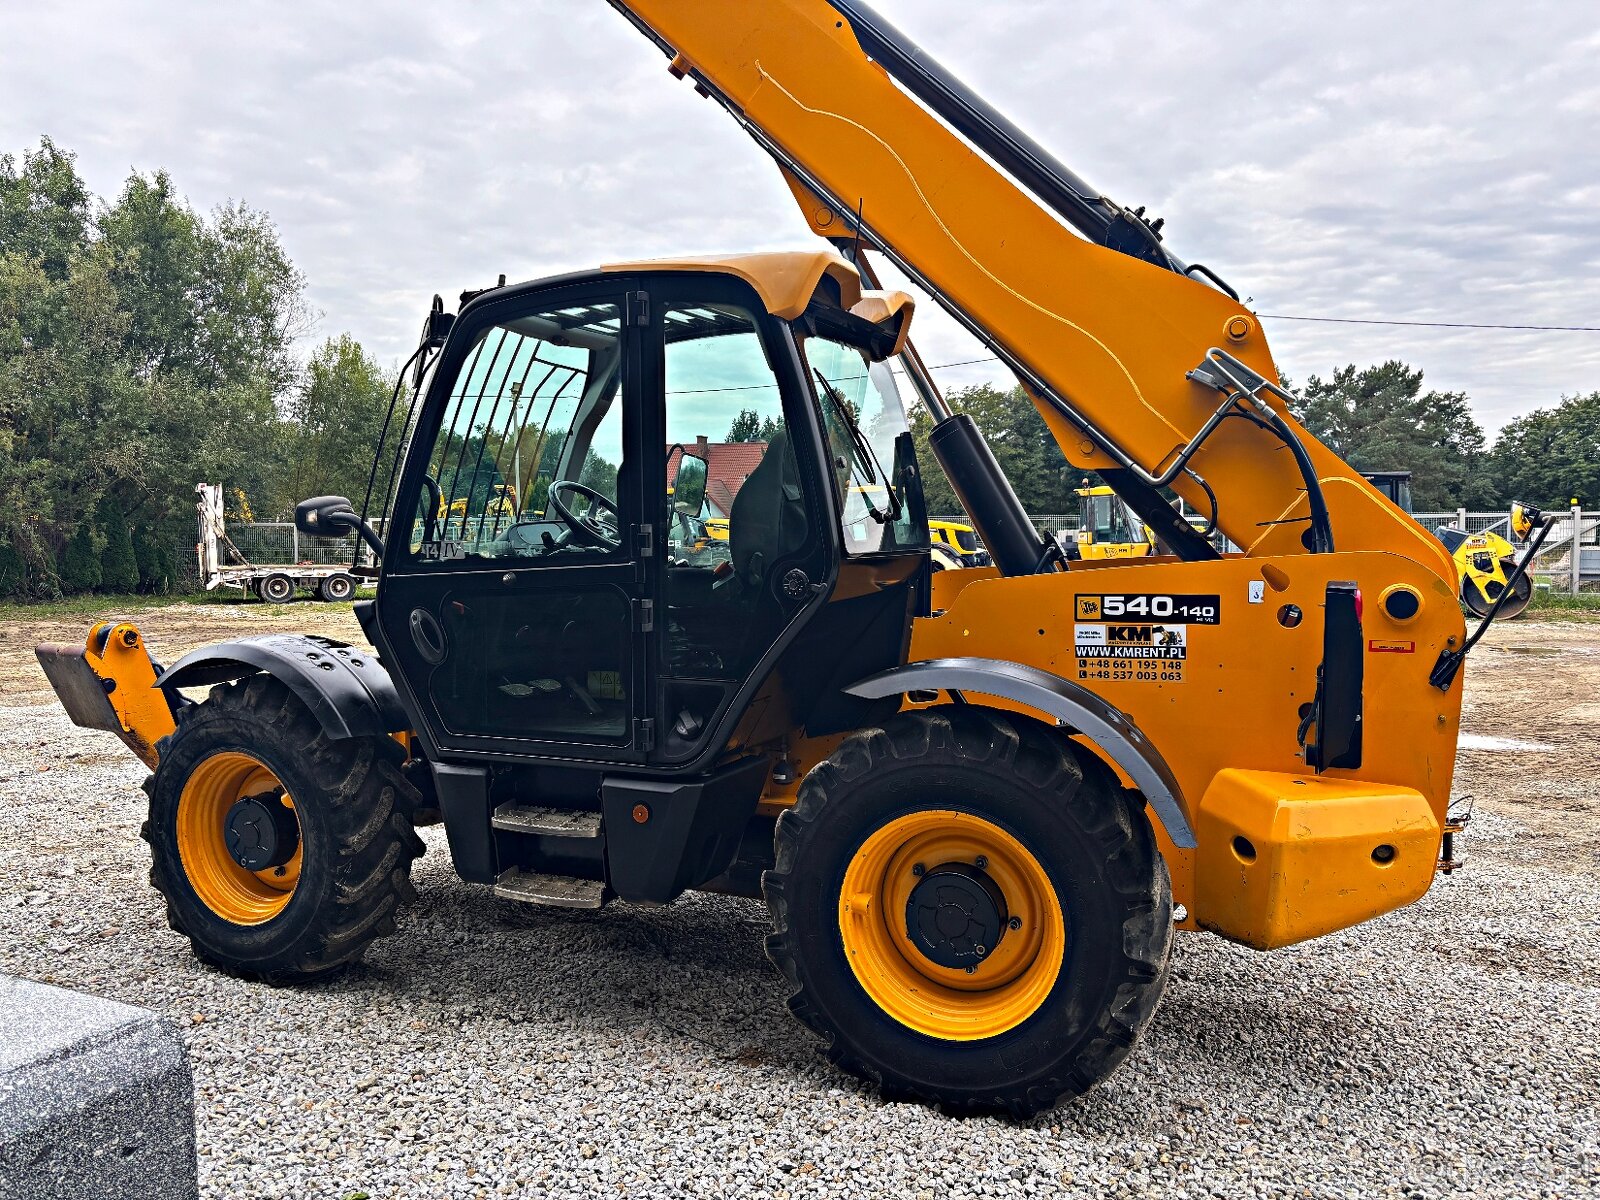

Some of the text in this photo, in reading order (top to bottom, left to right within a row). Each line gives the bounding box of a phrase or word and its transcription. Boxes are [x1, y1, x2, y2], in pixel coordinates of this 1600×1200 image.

[1102, 596, 1215, 617] 540-140
[1107, 626, 1151, 641] KM
[1076, 646, 1185, 658] WWW.KMRENT.PL
[1089, 659, 1182, 670] +48 661 195 148
[1089, 670, 1182, 681] +48 537 003 063
